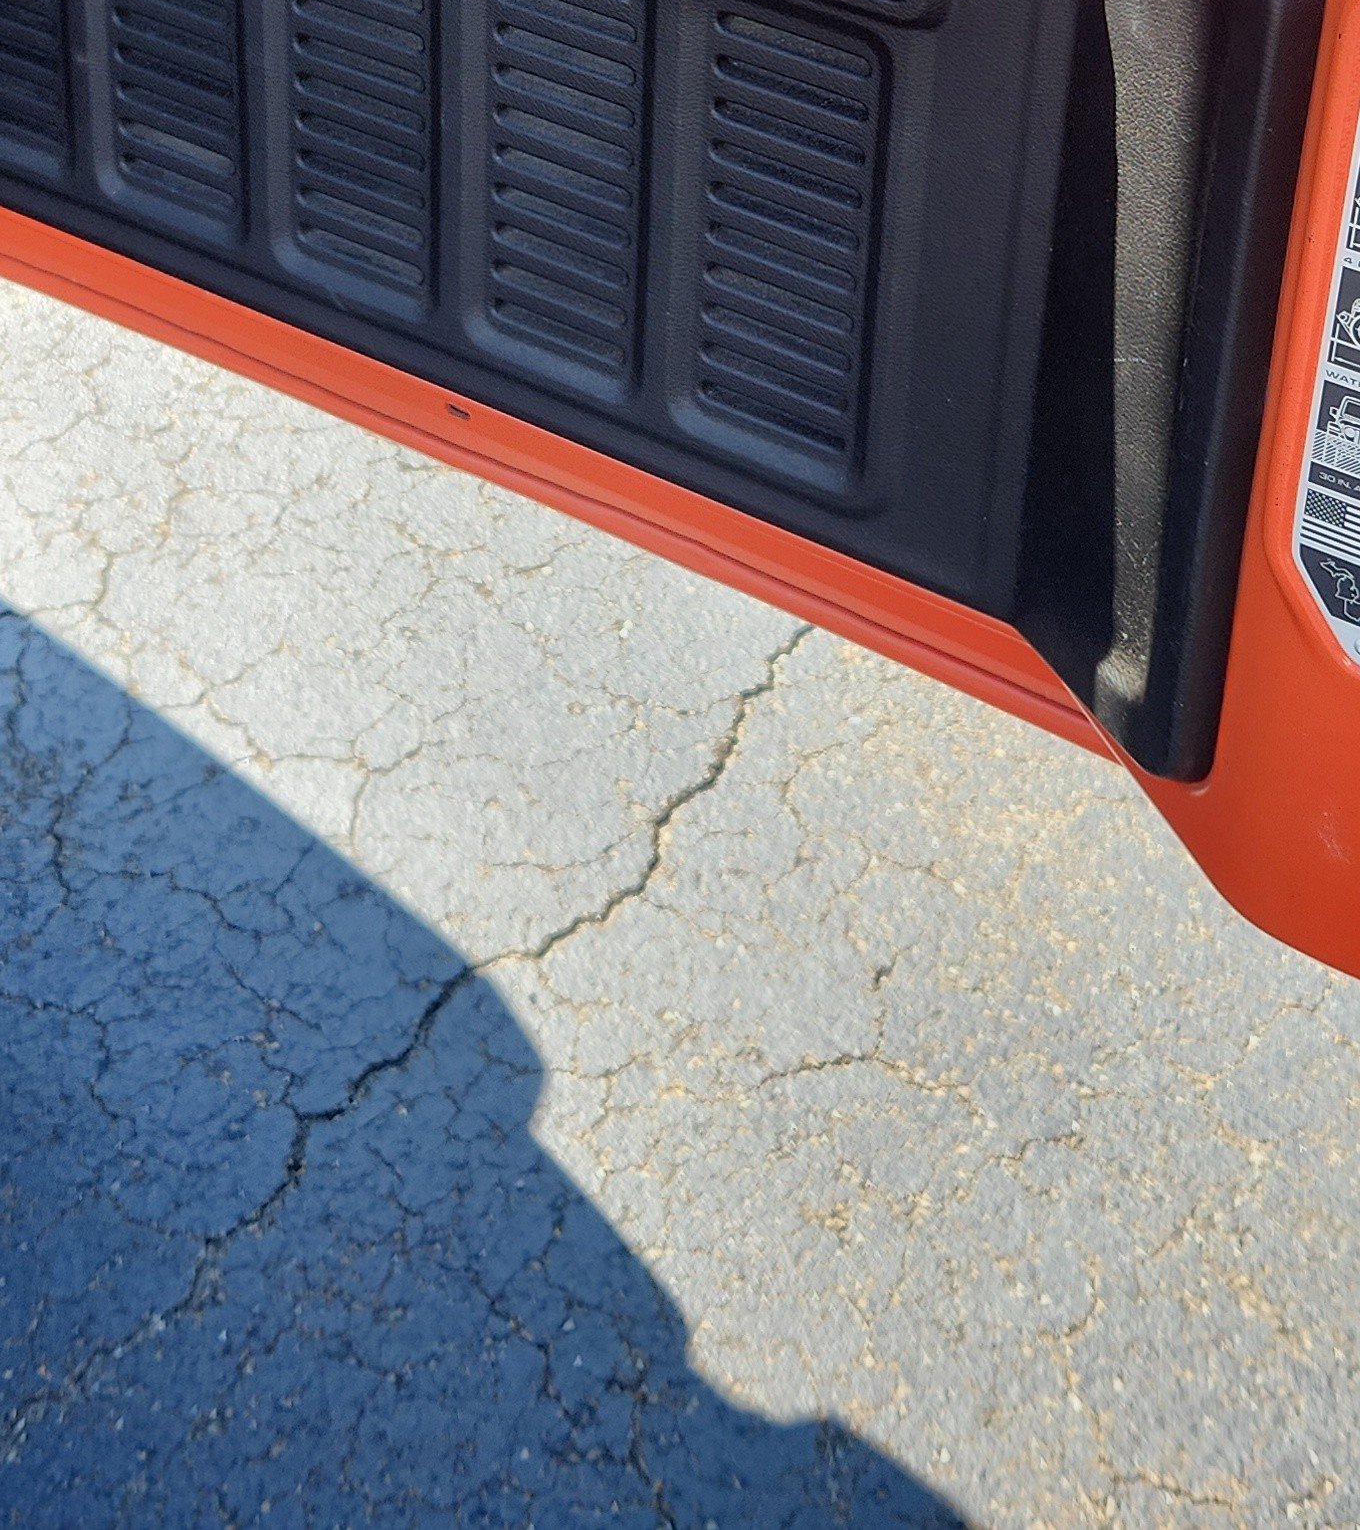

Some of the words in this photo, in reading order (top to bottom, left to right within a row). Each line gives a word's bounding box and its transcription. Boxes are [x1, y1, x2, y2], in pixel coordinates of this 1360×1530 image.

[1343, 256, 1353, 265] 4
[1318, 471, 1336, 483] 30
[1337, 478, 1352, 490] IN.
